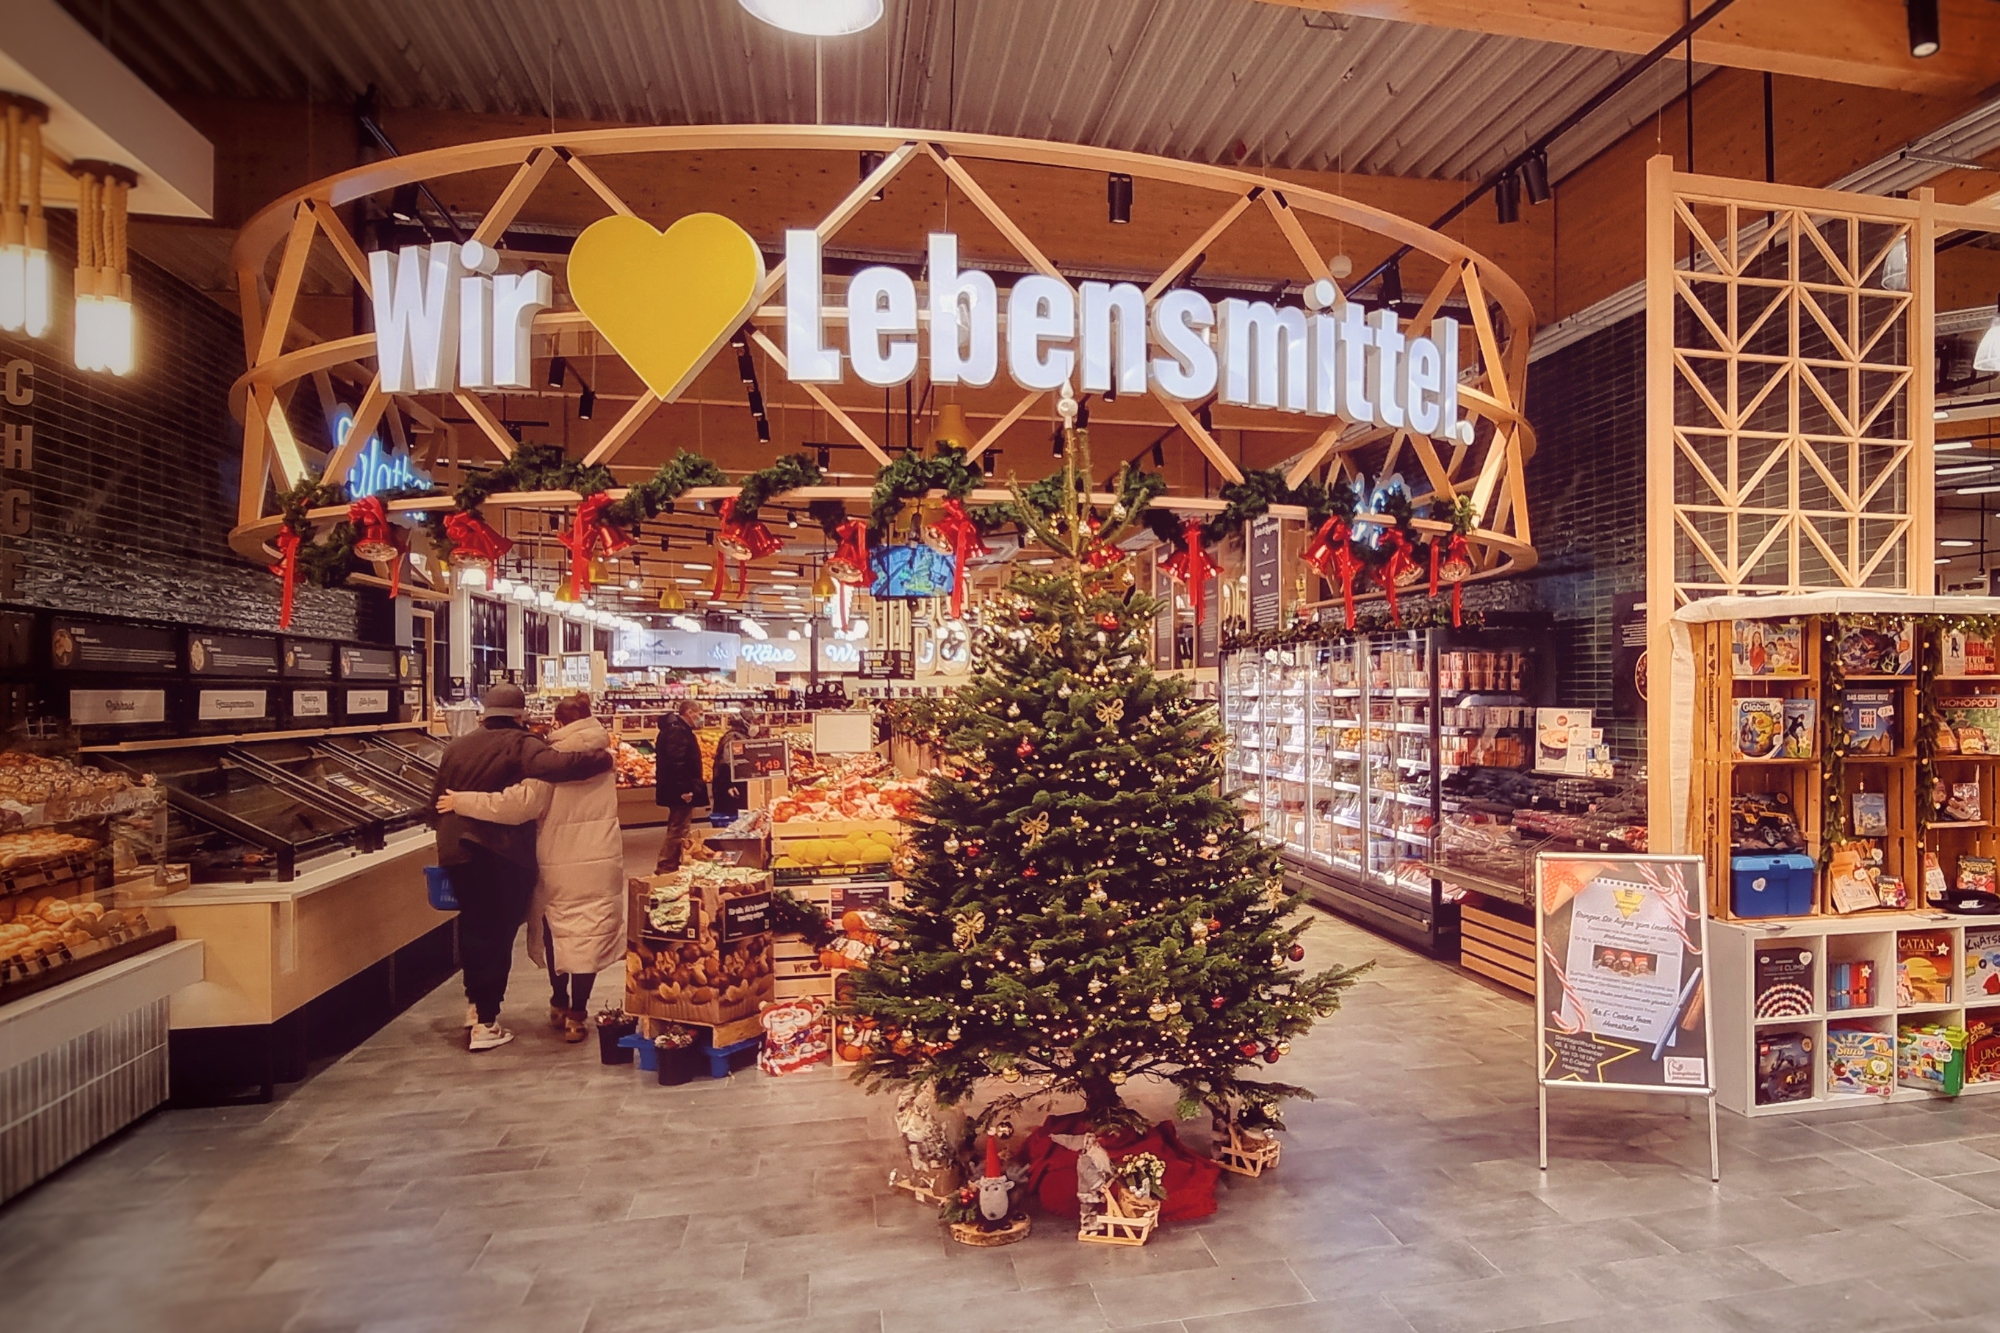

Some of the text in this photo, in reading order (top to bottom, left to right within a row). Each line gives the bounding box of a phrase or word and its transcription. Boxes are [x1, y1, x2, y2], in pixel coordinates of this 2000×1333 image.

[368, 239, 550, 393] Wir
[741, 643, 797, 666] Käse
[1741, 702, 1771, 713] Globus
[1939, 698, 1998, 709] MONOPOLY
[754, 760, 781, 773] 1,49
[1575, 911, 1601, 923] Bringen
[1614, 917, 1634, 929] Augen
[1634, 921, 1650, 930] zum
[1898, 938, 1935, 951] CATAN
[1612, 1011, 1634, 1022] Center
[1635, 1015, 1652, 1025] Team
[1969, 1021, 1986, 1034] UNO
